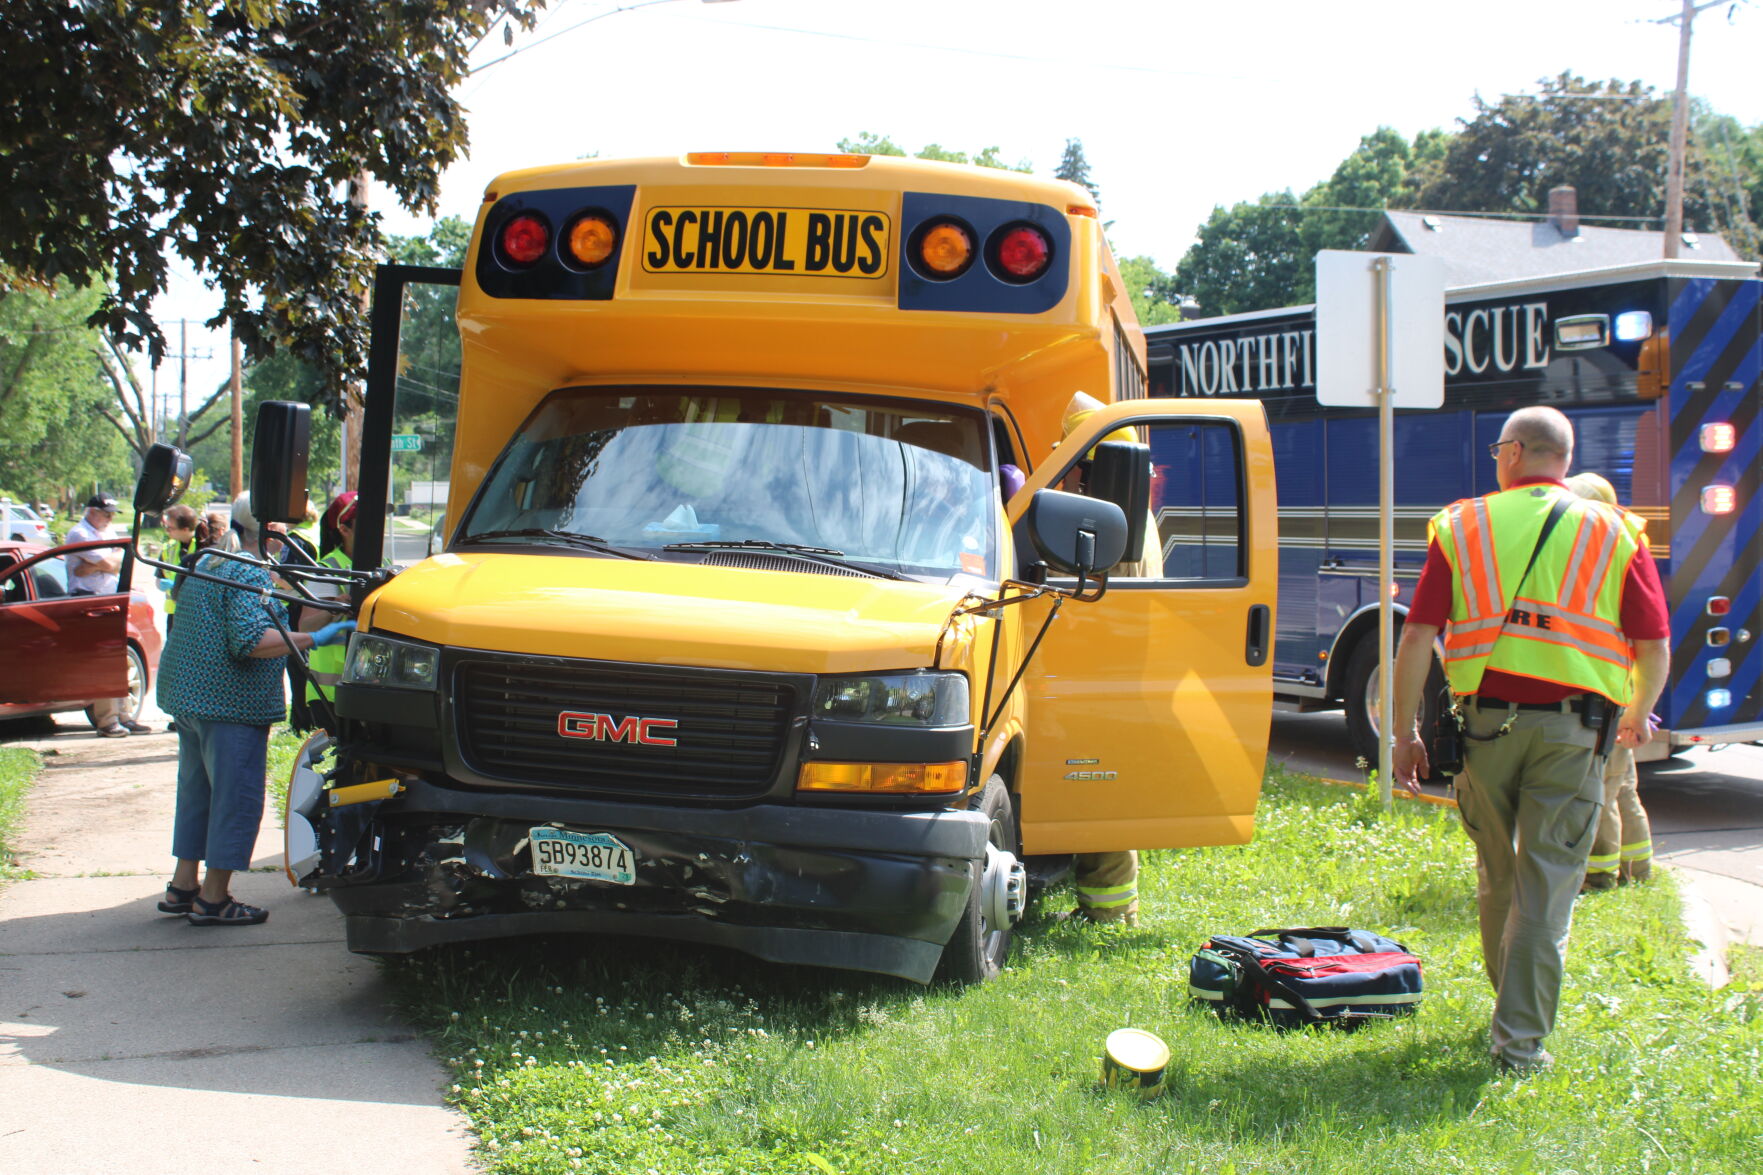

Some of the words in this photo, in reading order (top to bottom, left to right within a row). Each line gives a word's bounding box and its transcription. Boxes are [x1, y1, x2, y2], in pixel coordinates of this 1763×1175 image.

[647, 210, 796, 271] SCHOOL
[804, 212, 884, 275] BUS
[1179, 330, 1314, 397] NORTHFI
[1443, 302, 1549, 376] SCUE
[1509, 608, 1551, 630] RE
[558, 710, 678, 747] GMC
[1064, 771, 1118, 781] 4500
[538, 841, 627, 872] SB93874
